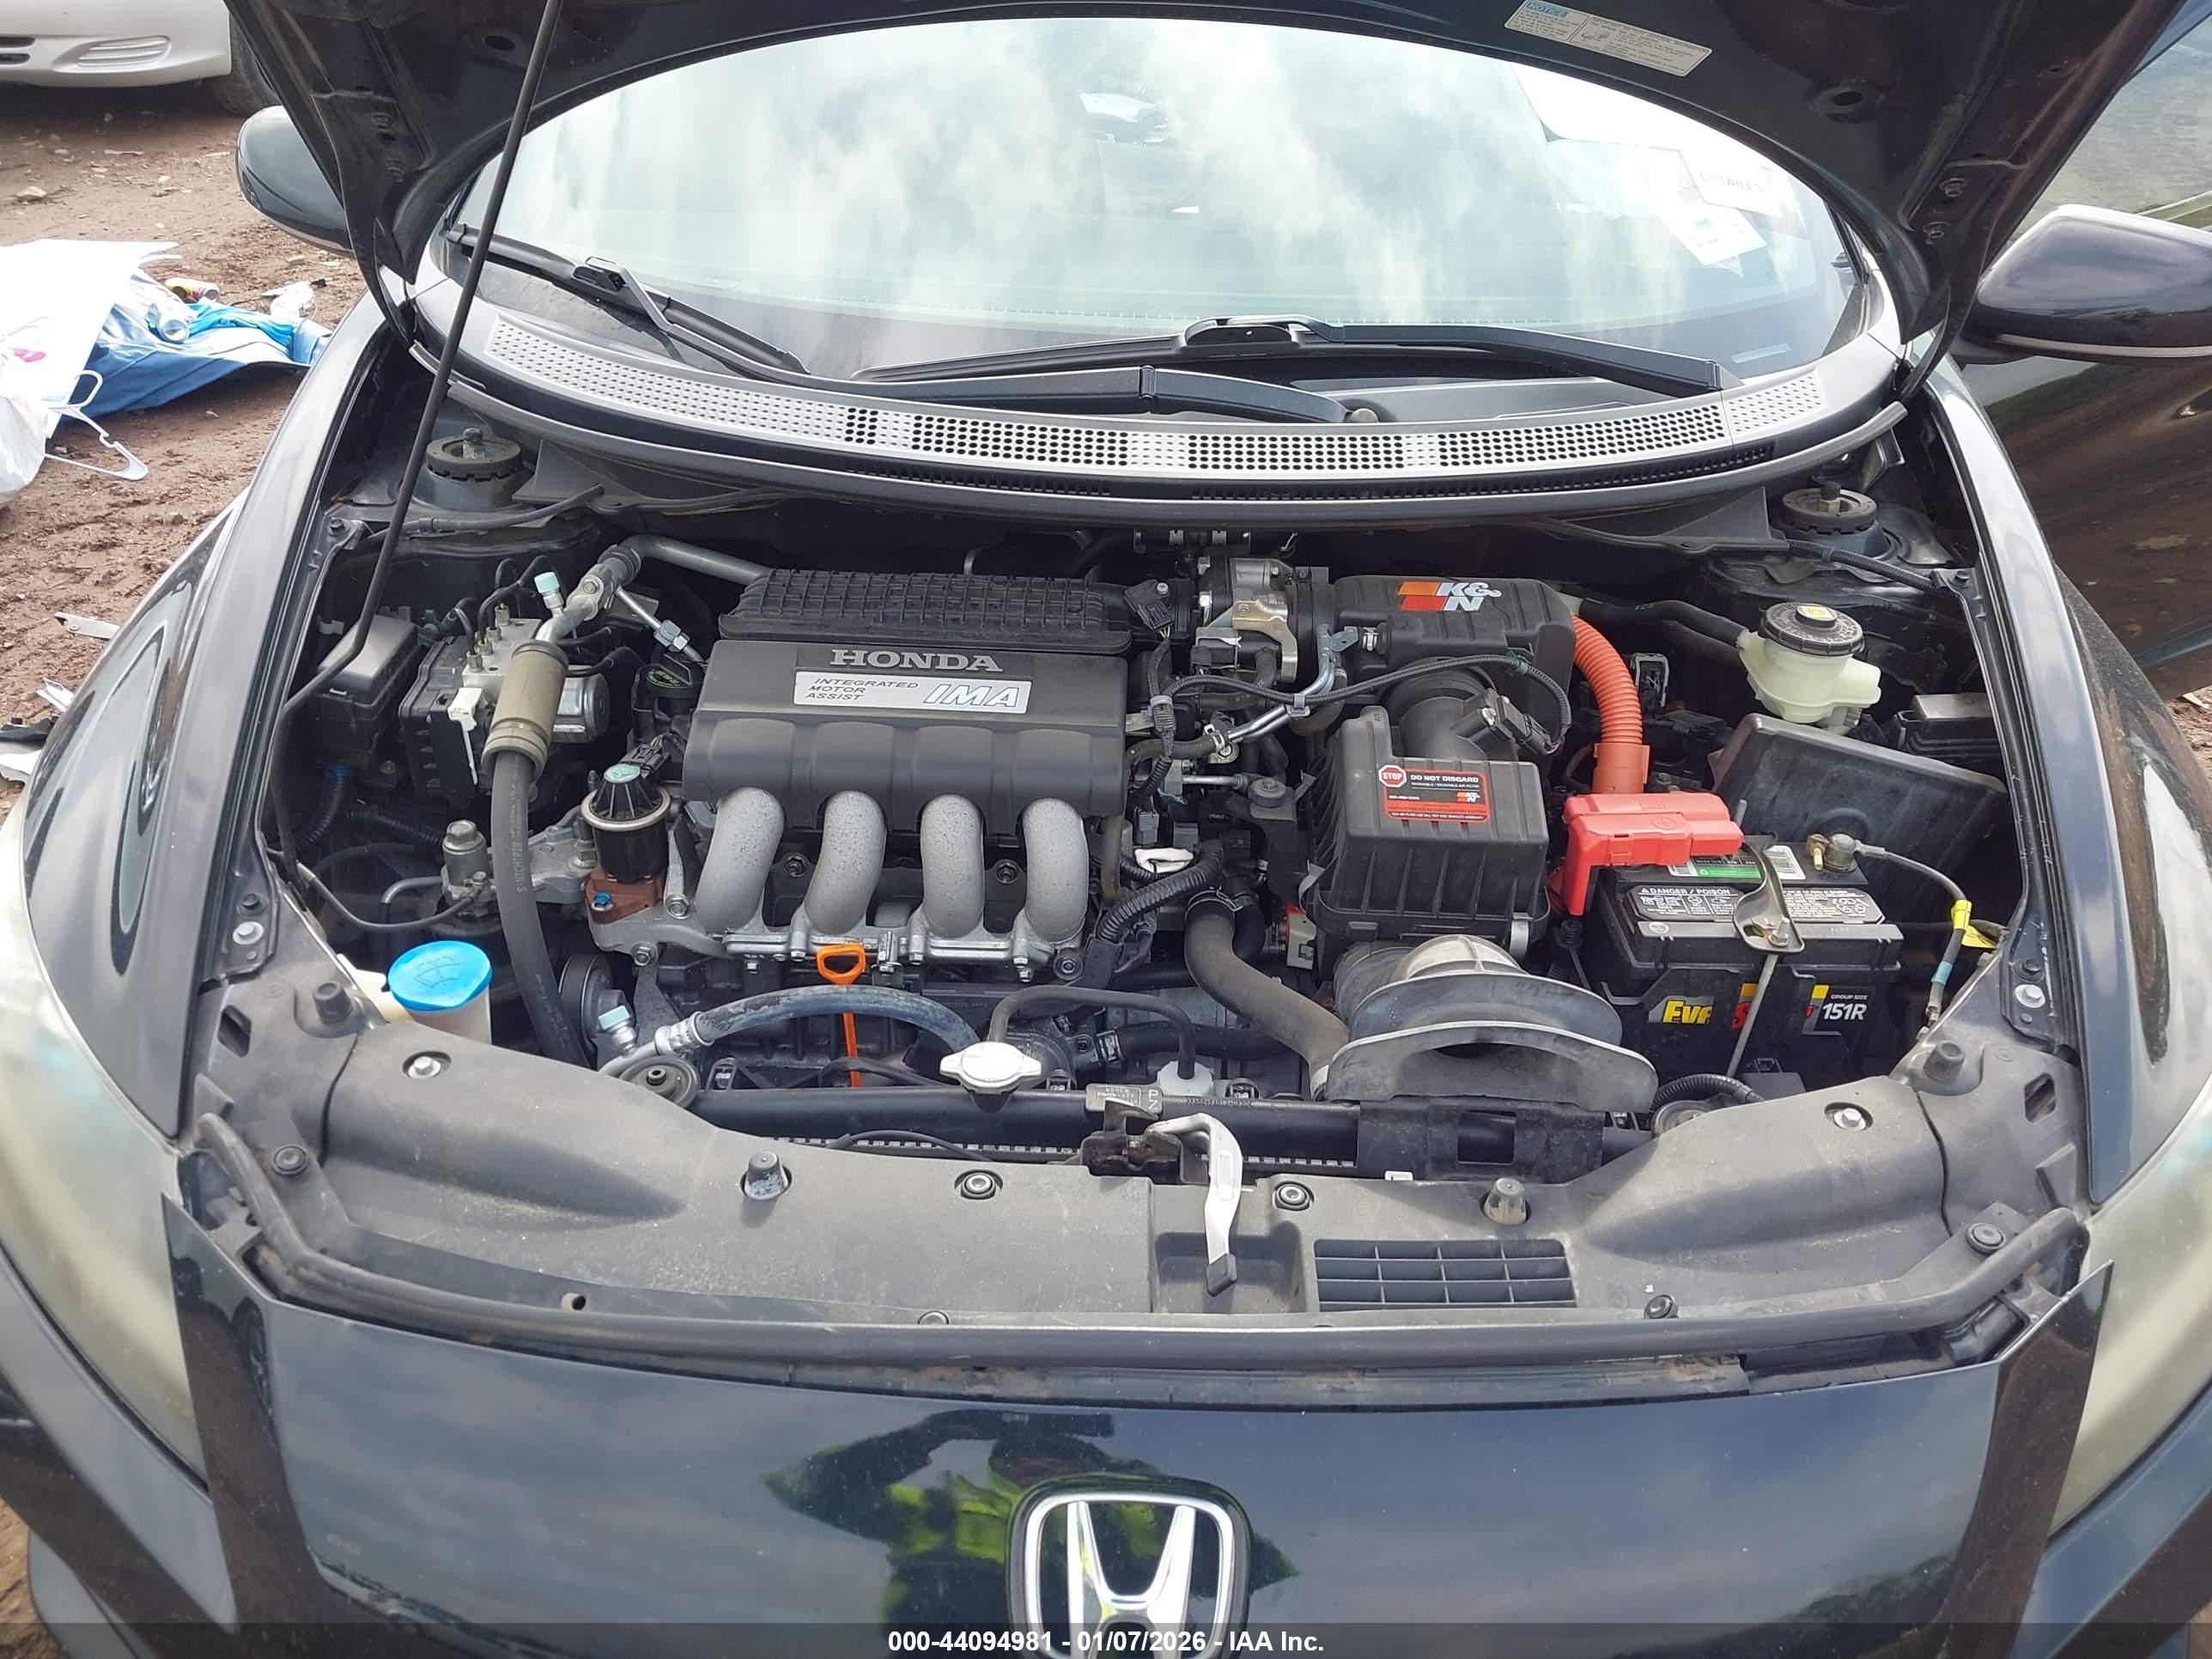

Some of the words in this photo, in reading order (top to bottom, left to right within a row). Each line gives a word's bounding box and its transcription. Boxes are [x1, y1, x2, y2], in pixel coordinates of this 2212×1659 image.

[830, 648, 1004, 672] HONDA
[814, 678, 920, 689] INTEGRATED
[805, 692, 865, 702] ASSIST
[922, 684, 1020, 708] IMA
[1382, 772, 1403, 781] STOP
[1822, 1003, 1868, 1020] 151R
